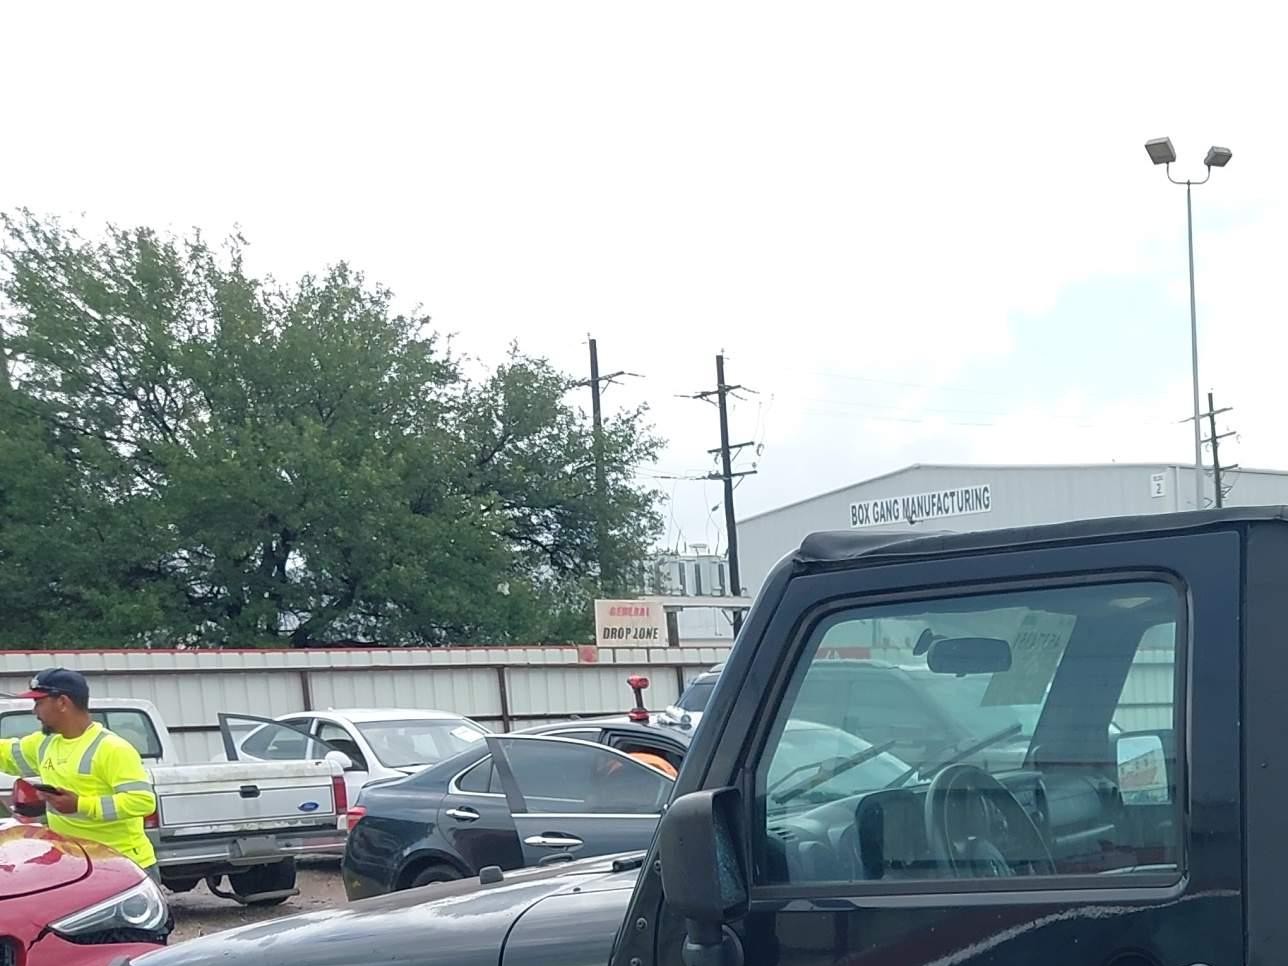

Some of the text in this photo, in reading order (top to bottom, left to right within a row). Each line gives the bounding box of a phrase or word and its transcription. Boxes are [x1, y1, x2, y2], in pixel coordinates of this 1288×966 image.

[851, 486, 990, 526] BOX GANG MANUFACTURING
[603, 627, 632, 640] DROP
